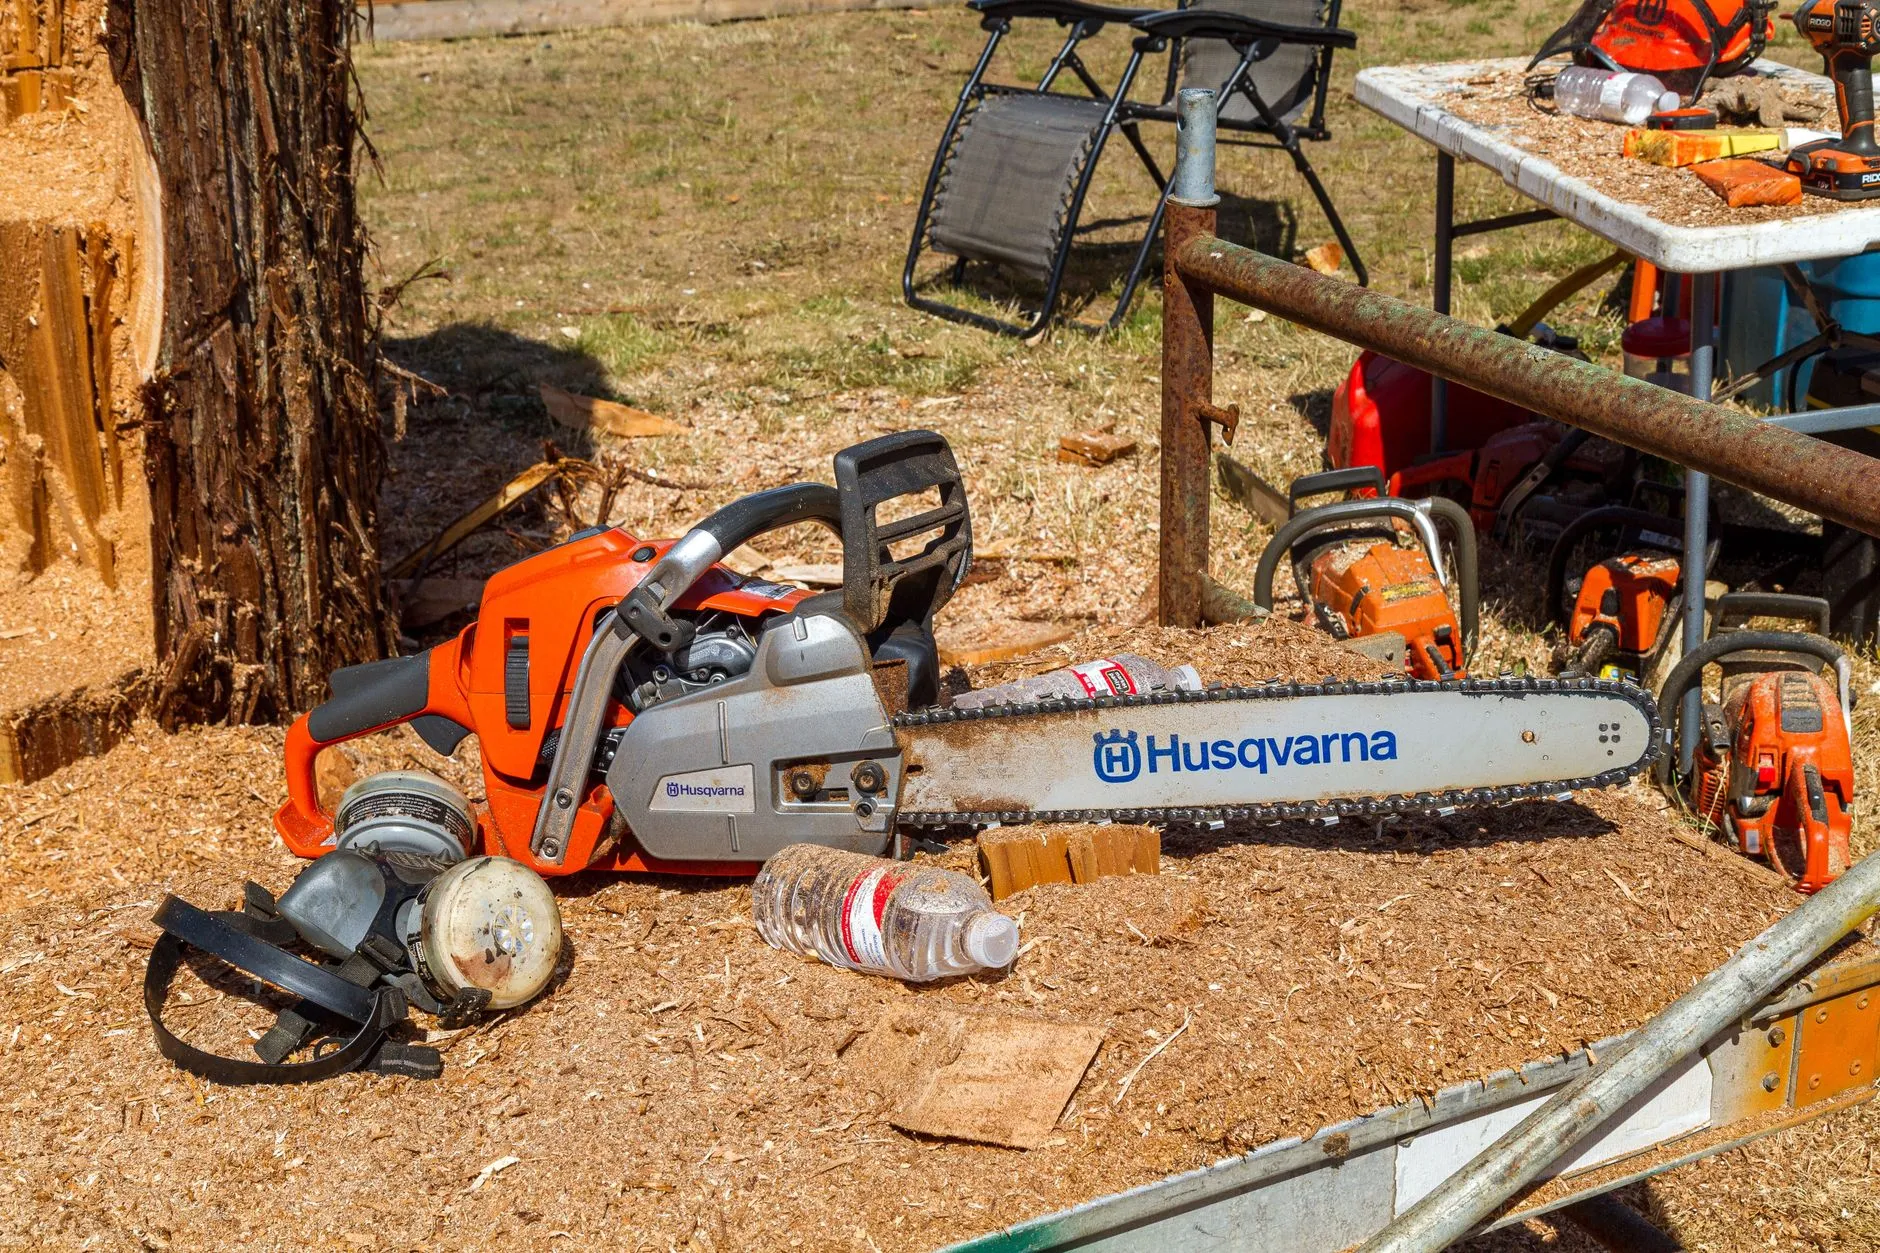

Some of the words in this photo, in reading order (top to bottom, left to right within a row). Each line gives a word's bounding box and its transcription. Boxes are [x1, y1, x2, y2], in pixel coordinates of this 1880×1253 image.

[1862, 172, 1880, 183] RID
[1146, 730, 1398, 775] Husqvarna
[680, 784, 745, 797] Husqvarna
